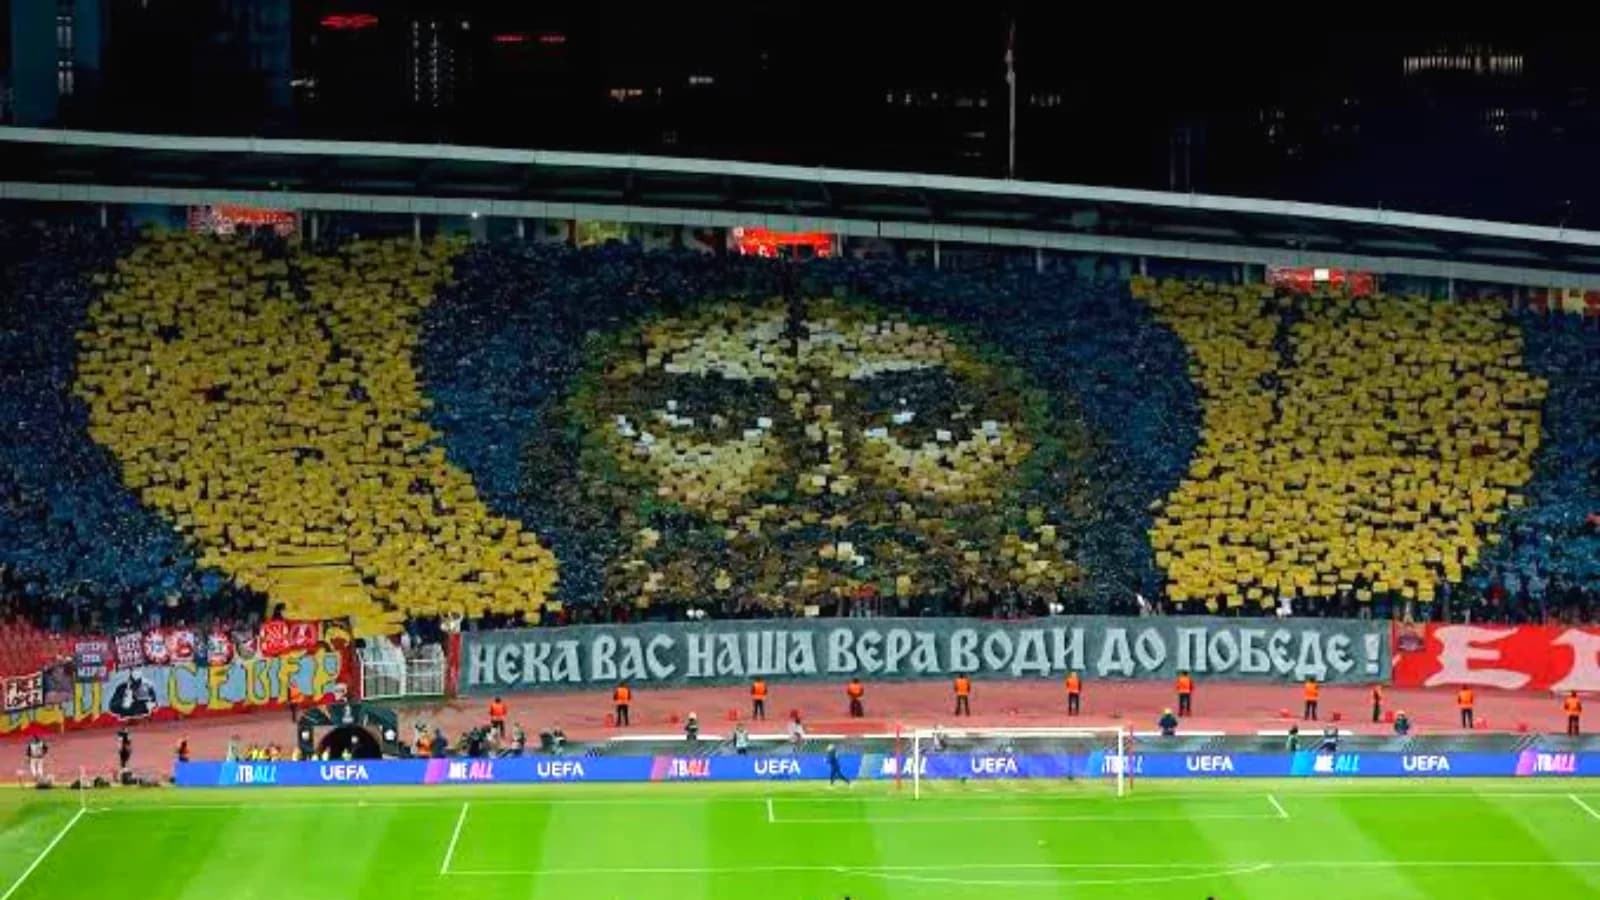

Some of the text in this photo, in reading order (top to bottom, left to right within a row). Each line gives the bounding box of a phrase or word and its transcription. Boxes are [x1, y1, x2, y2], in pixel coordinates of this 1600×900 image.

[469, 640, 581, 684] НЕКА
[591, 633, 677, 680] ВАС
[685, 630, 817, 677] НАША
[827, 629, 942, 674] ВЕРА
[950, 628, 1086, 677] ВОДИ
[1098, 628, 1167, 676] ДО
[1176, 629, 1354, 681] ПОБЕДЕ
[537, 761, 584, 777] UEFA
[754, 759, 801, 774] UEFA
[971, 757, 1018, 773] UEFA
[1186, 756, 1233, 771] UEFA
[1403, 756, 1450, 771] UEFA
[320, 764, 369, 780] UEFA
